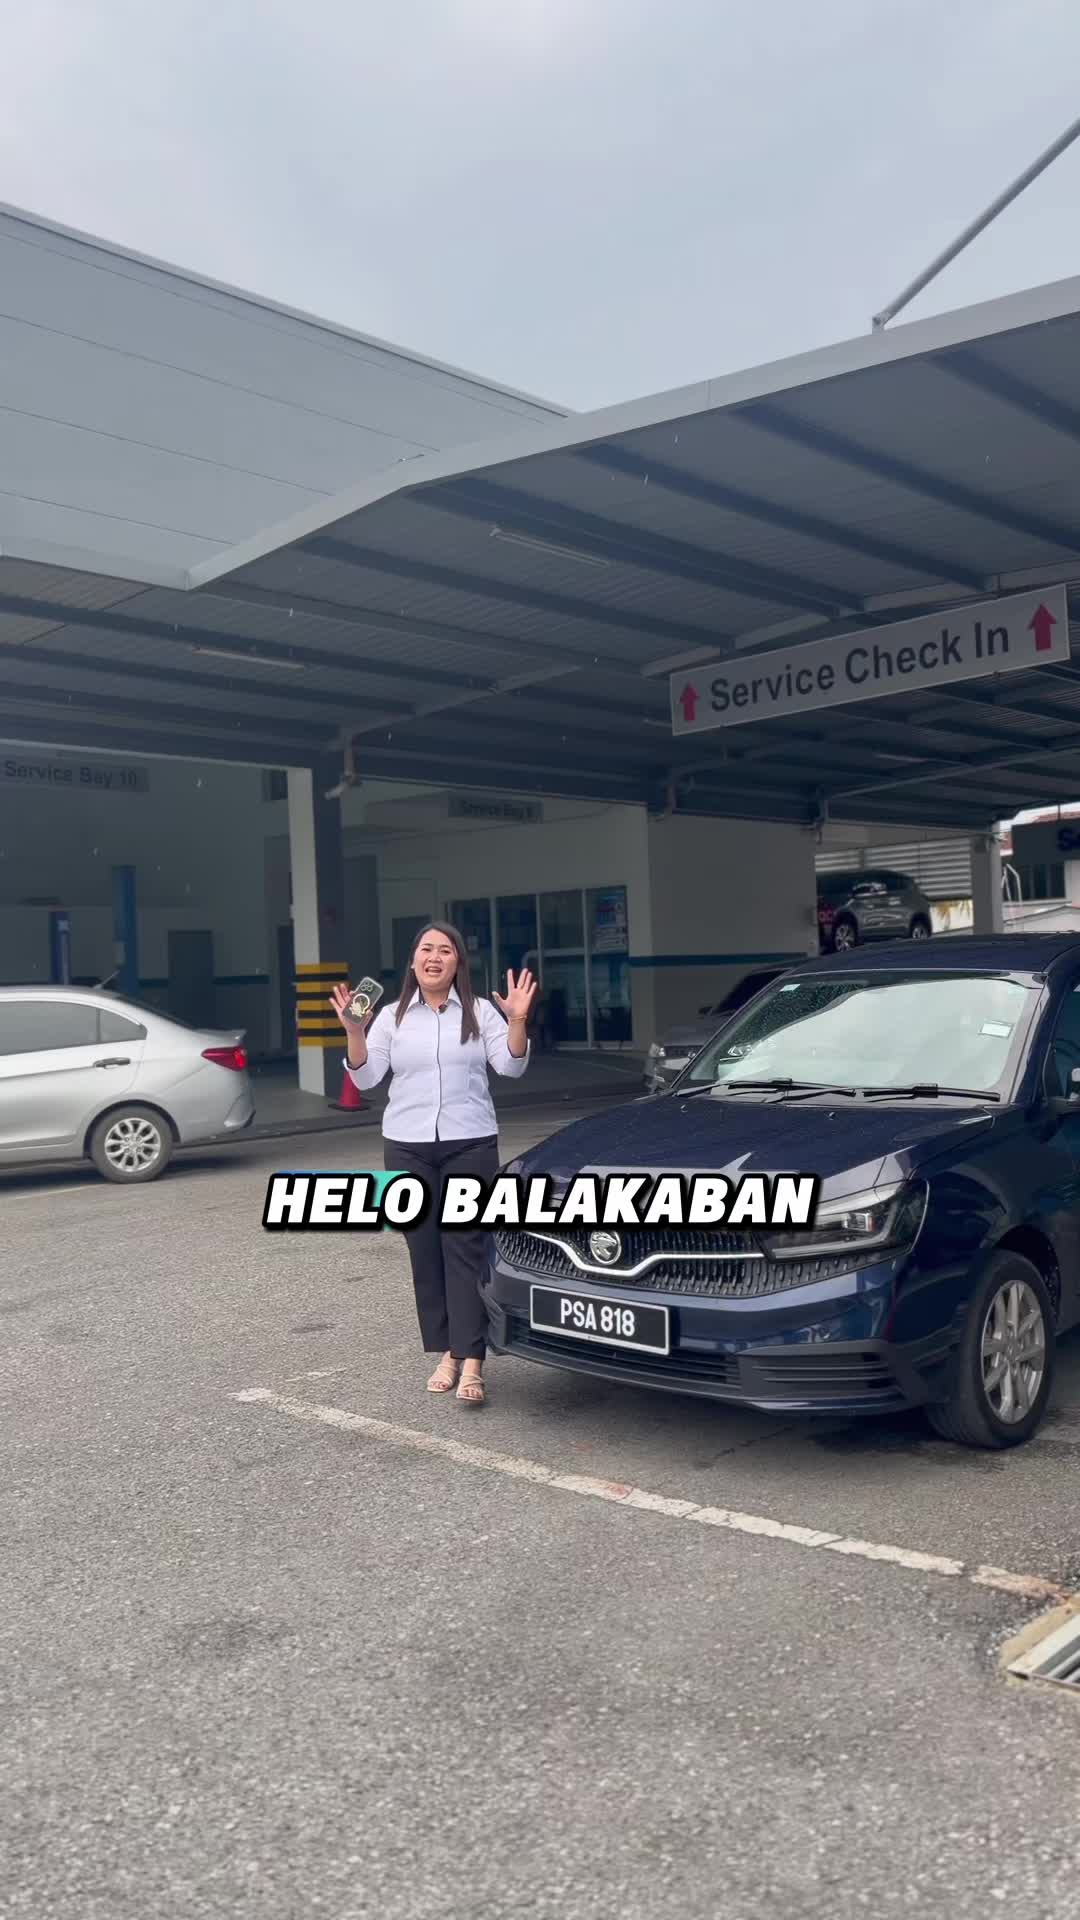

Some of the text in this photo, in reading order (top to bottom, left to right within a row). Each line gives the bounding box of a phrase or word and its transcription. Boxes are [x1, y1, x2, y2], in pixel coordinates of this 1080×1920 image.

[710, 621, 1010, 712] Service Check In
[4, 760, 73, 783] Service
[79, 766, 112, 789] Bay
[560, 1298, 636, 1337] PSA 818
